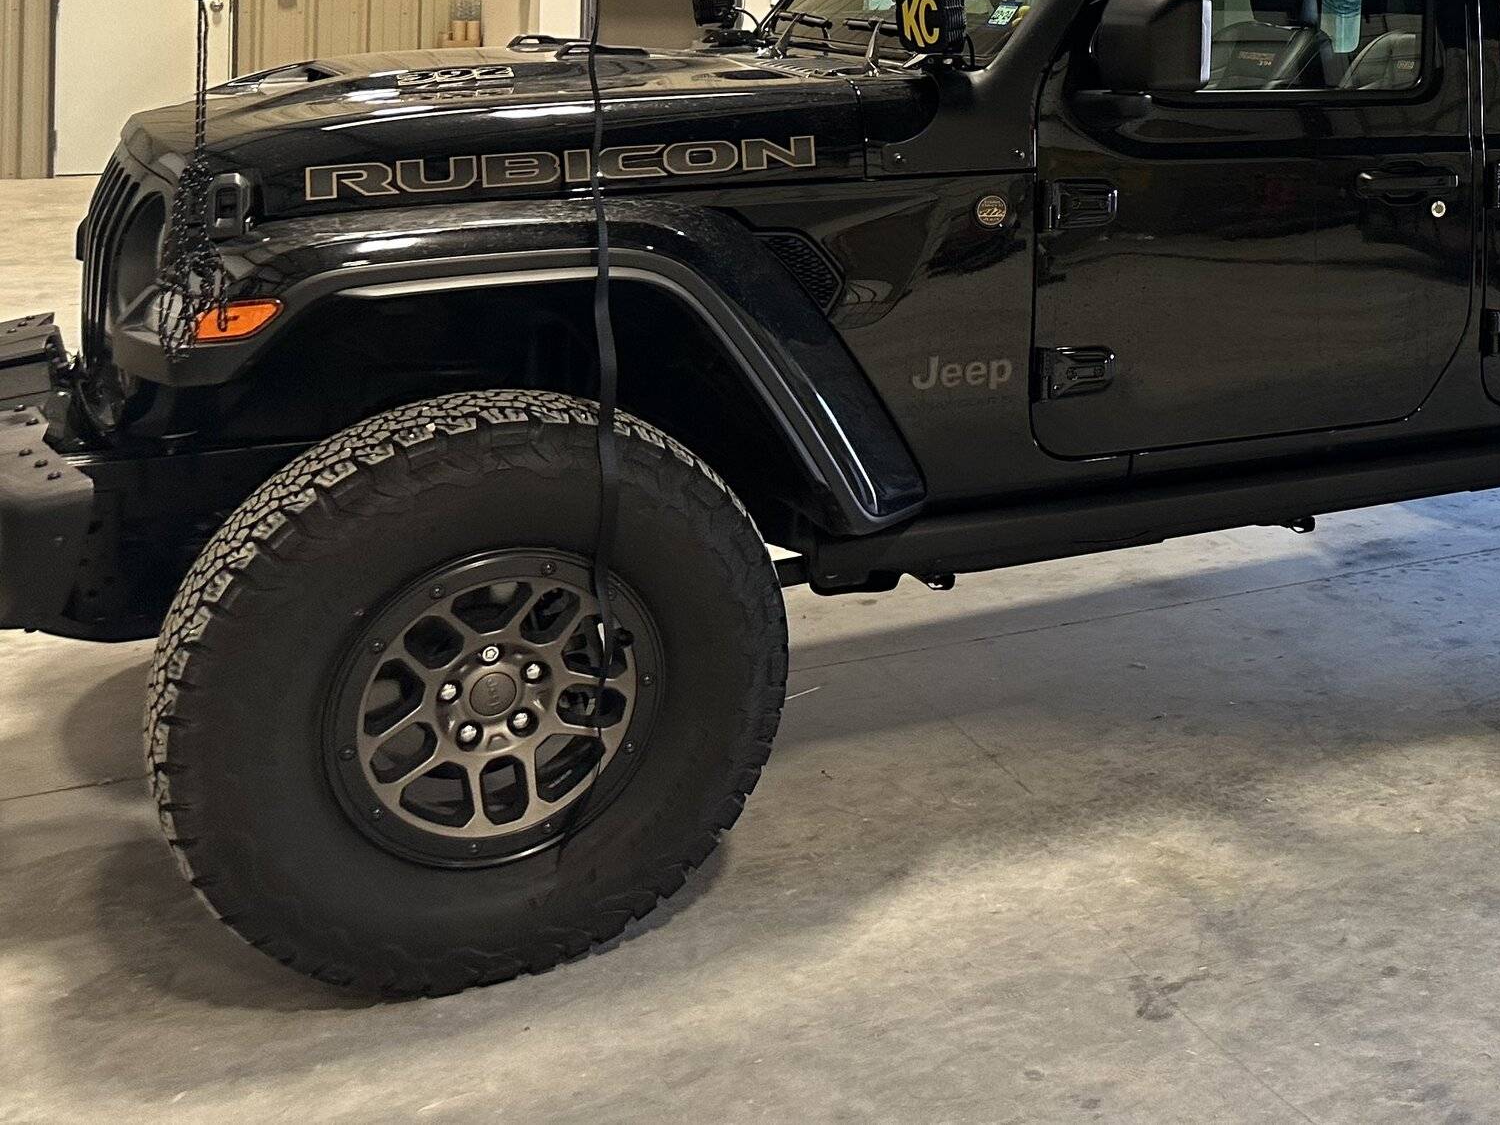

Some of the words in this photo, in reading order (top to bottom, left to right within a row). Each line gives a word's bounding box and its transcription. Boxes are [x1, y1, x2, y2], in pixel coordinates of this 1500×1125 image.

[396, 65, 515, 86] 392
[305, 135, 817, 201] RUBICON
[911, 354, 1013, 390] Jeep
